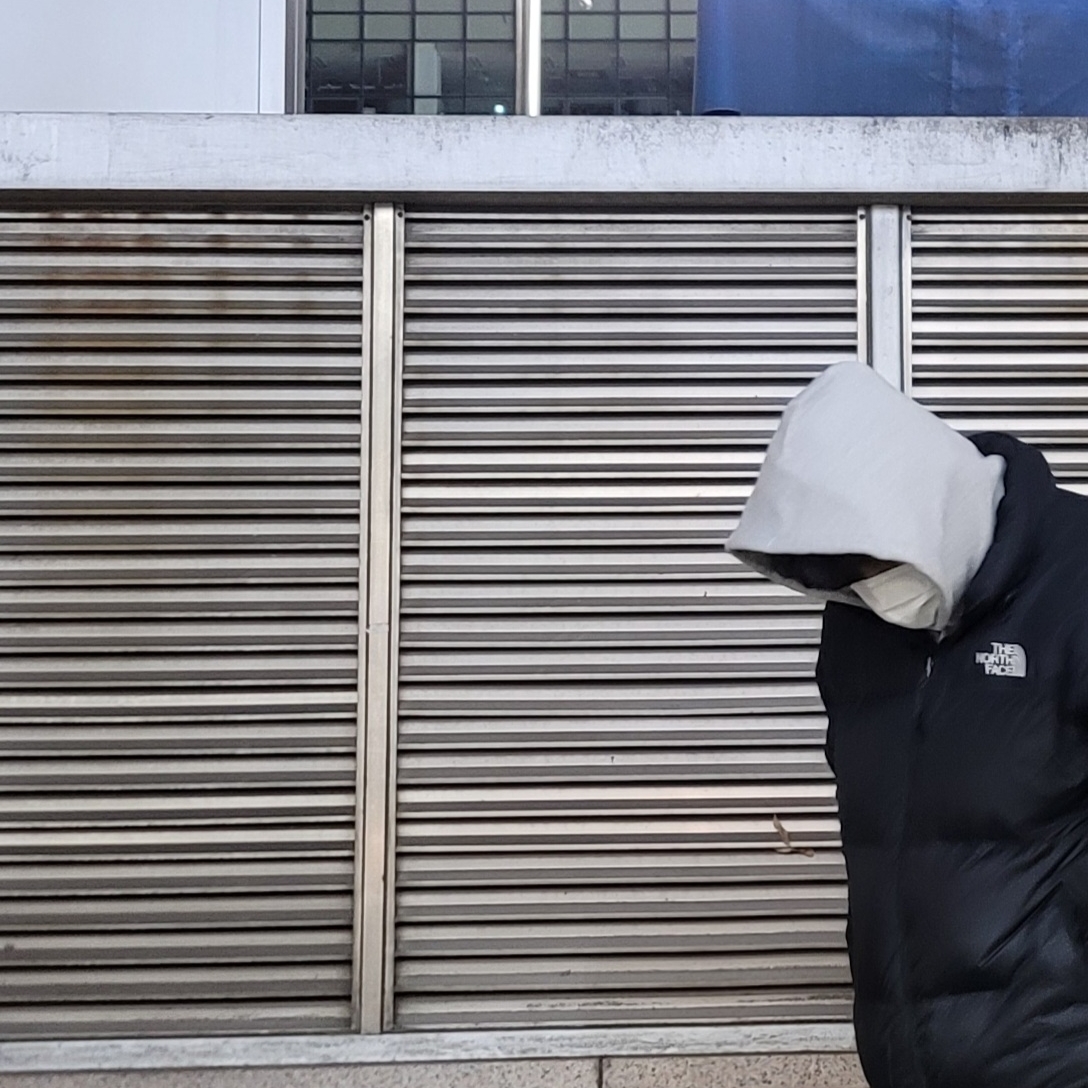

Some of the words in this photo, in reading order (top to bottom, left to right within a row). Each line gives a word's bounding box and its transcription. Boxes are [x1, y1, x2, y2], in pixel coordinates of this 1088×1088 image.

[990, 642, 1015, 654] THE
[975, 652, 1013, 665] NORTH
[985, 664, 1015, 675] FACE
